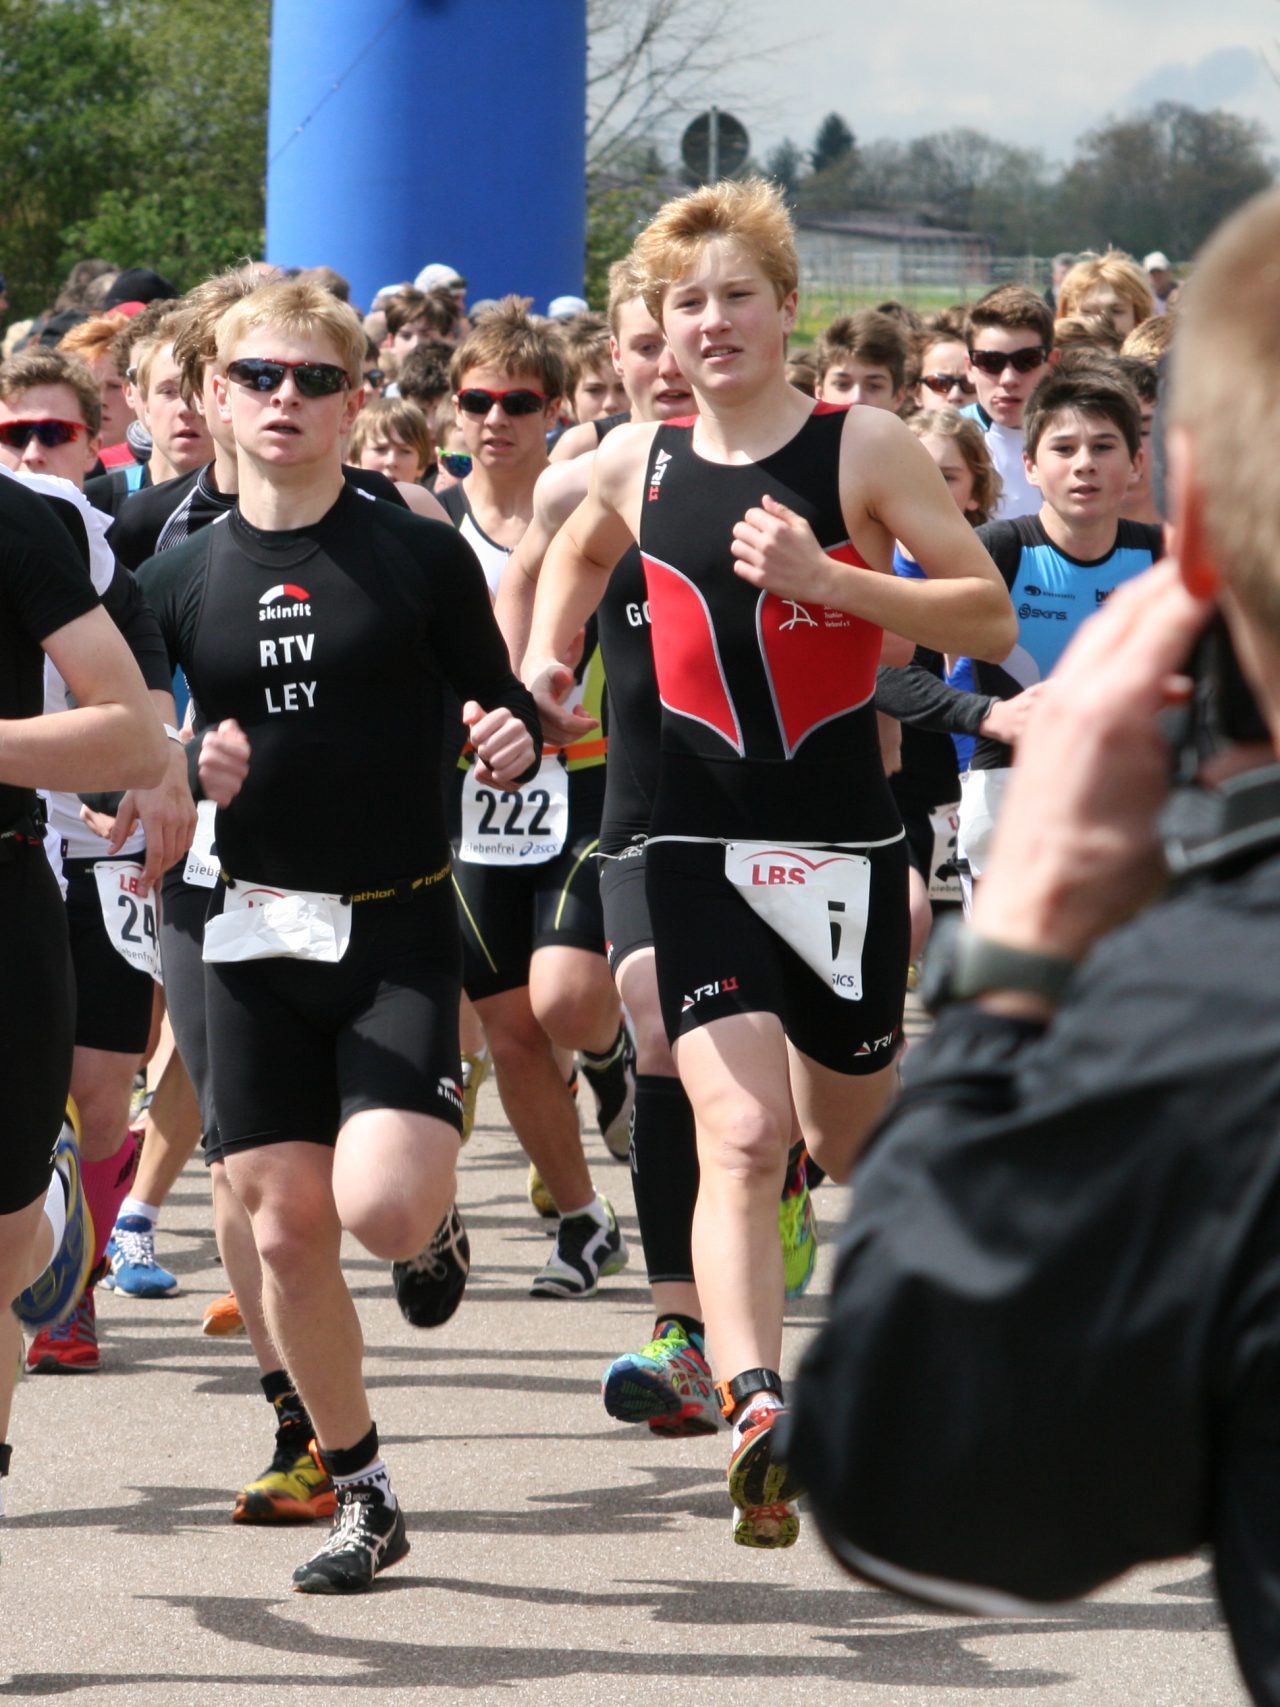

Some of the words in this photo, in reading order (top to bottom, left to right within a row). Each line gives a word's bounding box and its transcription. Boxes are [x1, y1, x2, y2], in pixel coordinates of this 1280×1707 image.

[258, 603, 312, 621] skinfit
[260, 633, 315, 667] RTV
[265, 681, 317, 713] LEY
[475, 789, 551, 835] 222
[752, 863, 806, 885] LBS
